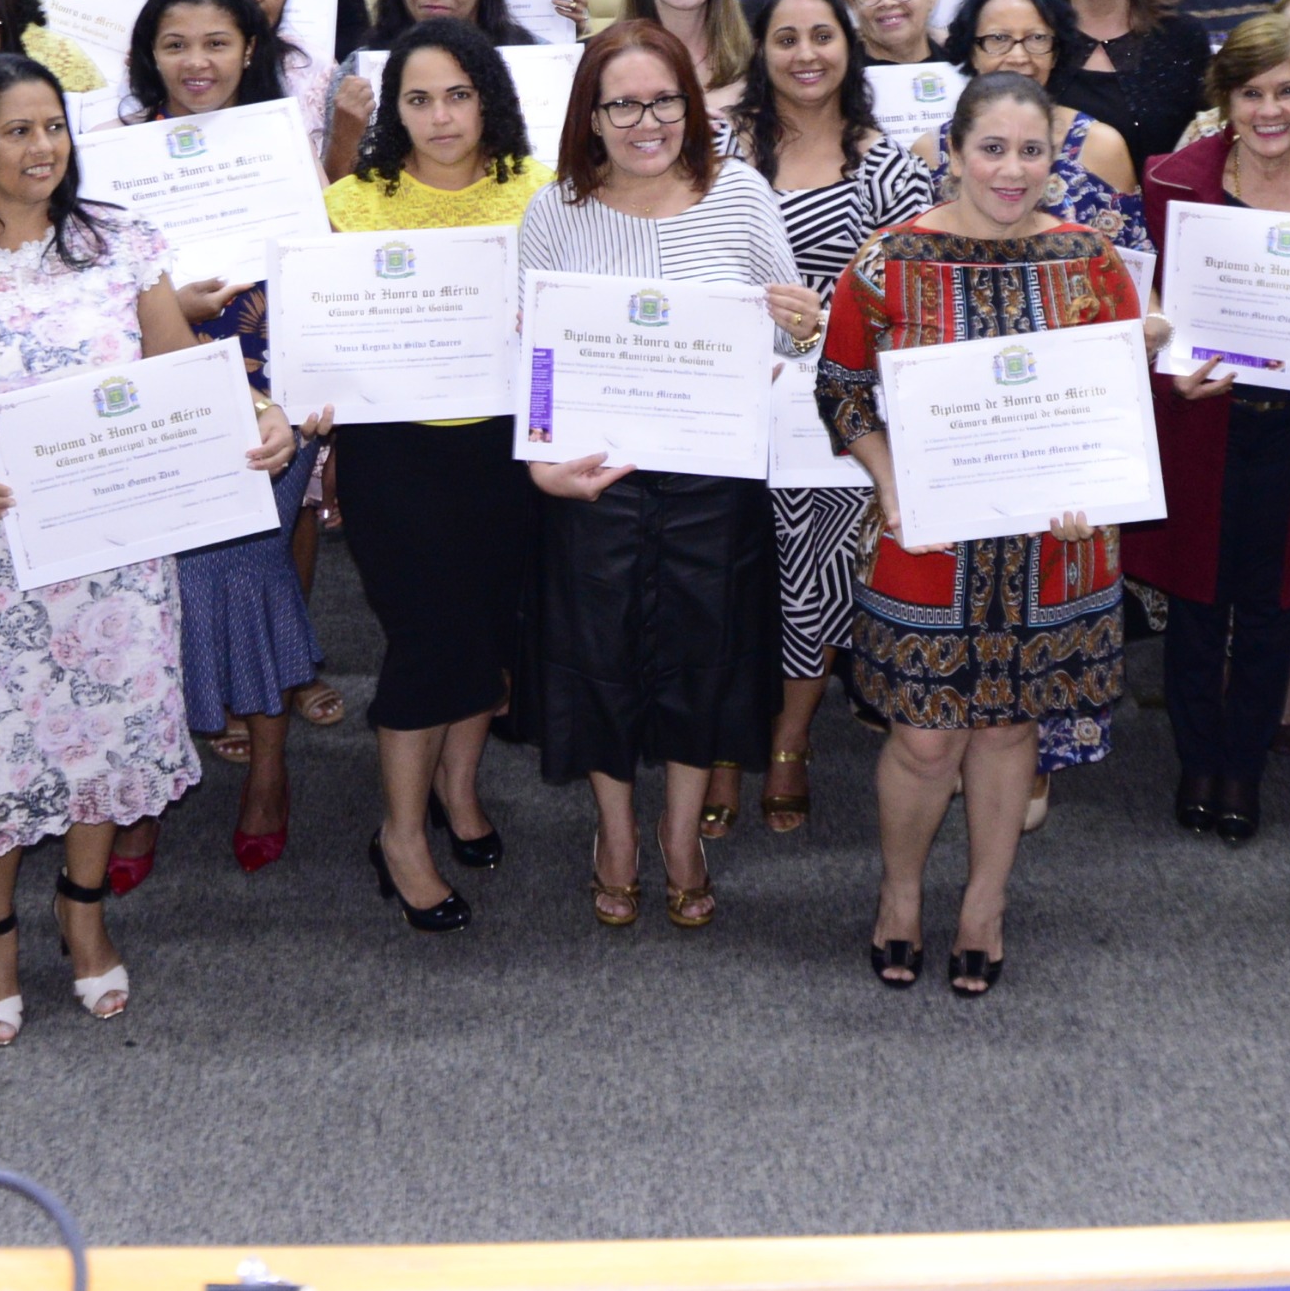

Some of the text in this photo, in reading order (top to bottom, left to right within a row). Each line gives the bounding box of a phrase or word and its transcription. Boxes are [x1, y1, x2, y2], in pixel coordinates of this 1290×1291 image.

[1204, 256, 1249, 271] Diploma
[1253, 262, 1265, 273] de
[310, 284, 479, 304] Diploma de Honra ao Mérito
[328, 302, 463, 317] Câmara Municipal de Goiânia
[563, 329, 732, 352] Diploma de Honra ao Mérito
[579, 347, 714, 366] Câmara Municipal de Goiânia
[627, 387, 653, 398] Maria
[929, 385, 1107, 416] Diploma de Honra ao Mérito
[949, 418, 987, 429] Câmara
[990, 410, 1037, 424] Municipal
[1040, 409, 1051, 418] de
[1053, 404, 1091, 416] Goiânia
[33, 406, 212, 457] Diploma de Honra ao Mérito
[55, 452, 94, 467] Câmara
[96, 439, 144, 457] Municipal
[146, 436, 158, 445] de
[160, 427, 198, 441] Goiânia
[126, 474, 157, 487] Gomes
[157, 467, 180, 480] Dias
